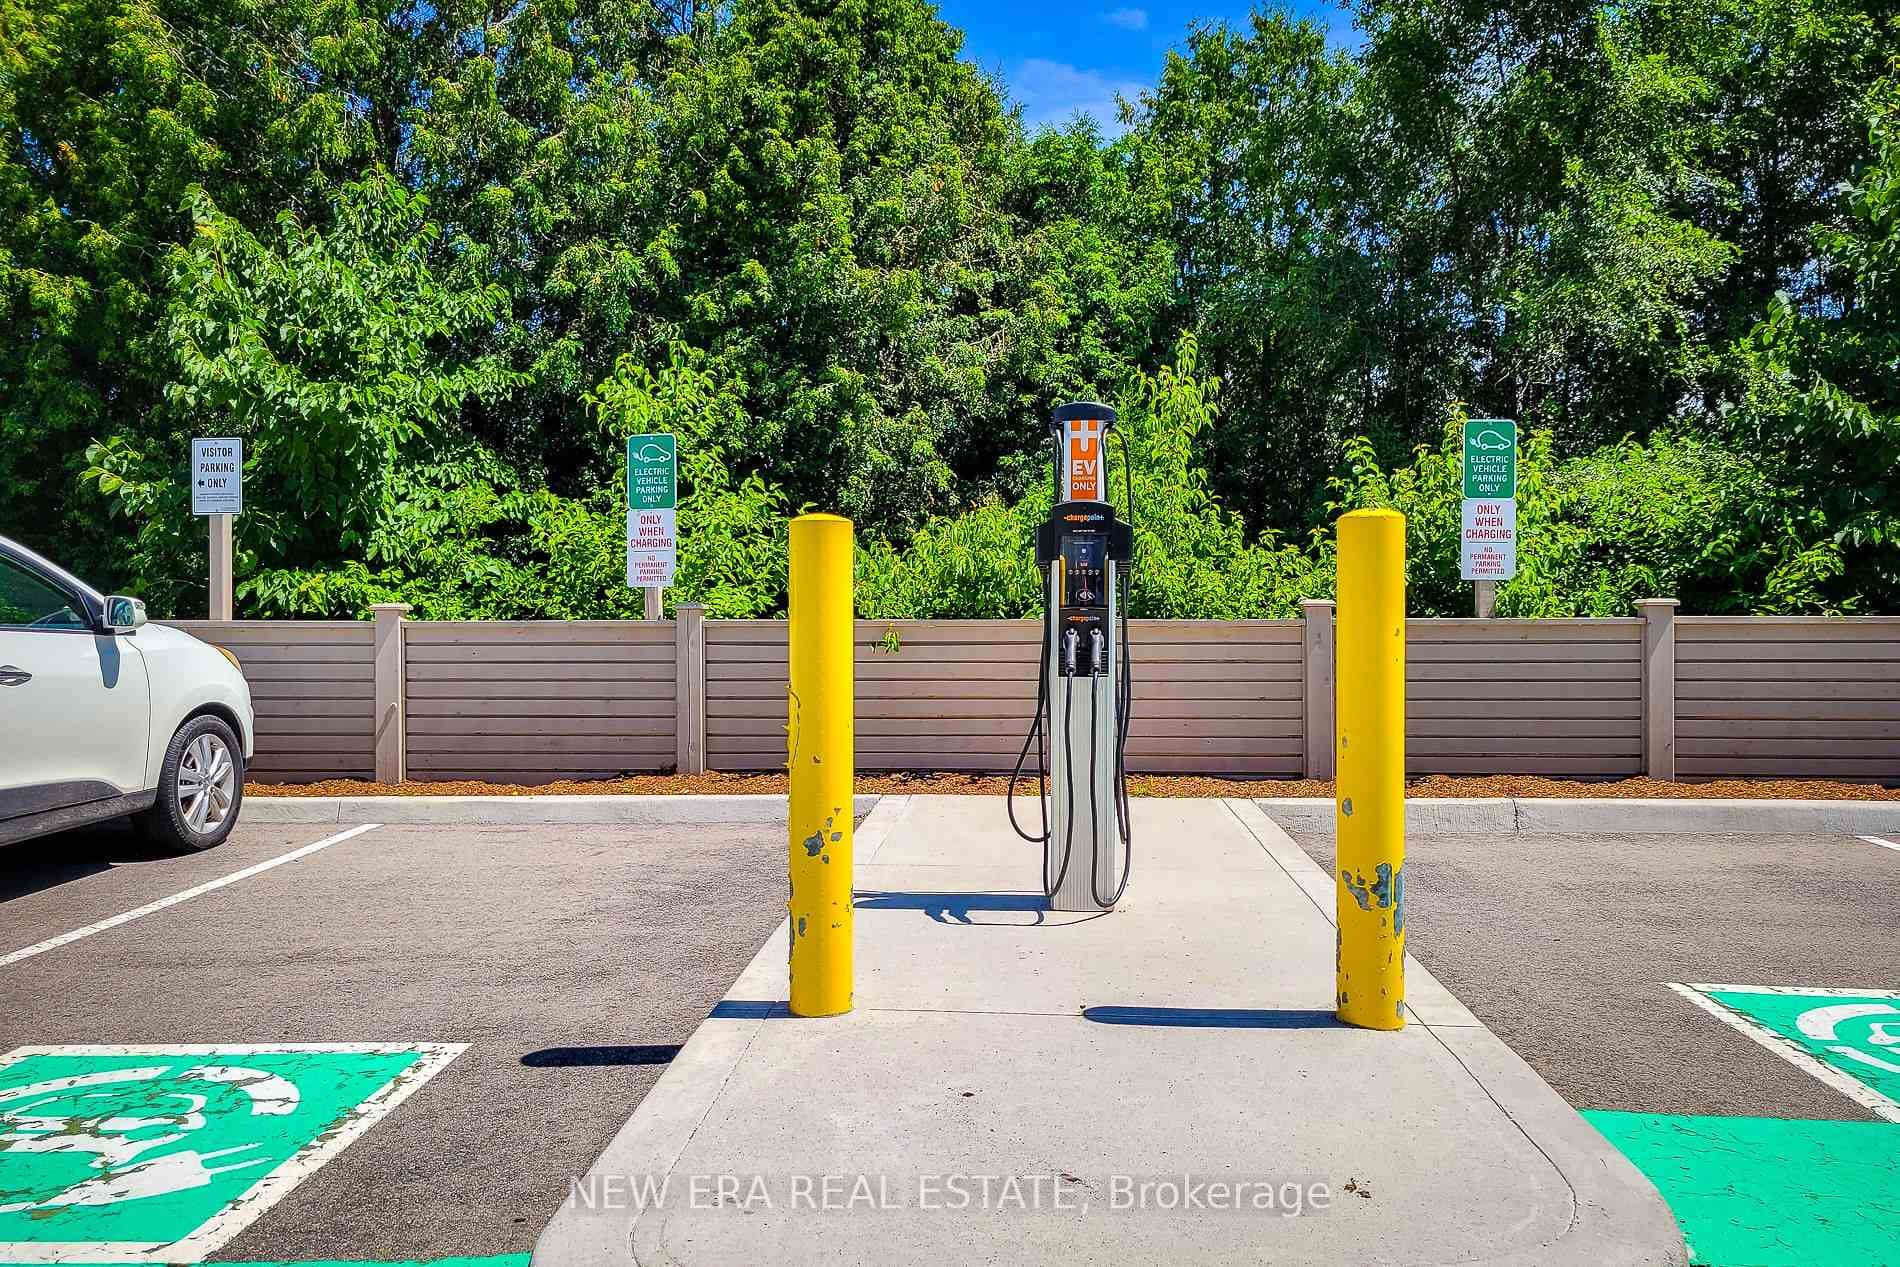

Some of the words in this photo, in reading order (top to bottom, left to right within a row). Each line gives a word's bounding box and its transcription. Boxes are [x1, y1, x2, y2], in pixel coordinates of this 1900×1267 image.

[201, 447, 233, 458] VISITOR
[1470, 455, 1509, 464] ELECTRIC
[200, 462, 235, 473] PARKING
[634, 467, 670, 476] ELECTRIC
[1072, 459, 1097, 475] EV
[1472, 464, 1508, 473] VEHICLE
[636, 476, 669, 485] VEHICLE
[1472, 474, 1508, 482] PARKING
[207, 478, 228, 489] ONLY
[1072, 481, 1096, 491] ONLY
[1478, 483, 1500, 492] ONLY
[636, 485, 669, 494] PARKING
[642, 495, 662, 503] ONLY
[1477, 504, 1501, 515] ONLY
[640, 515, 662, 525] ONLY
[1475, 517, 1503, 527] WHEN
[638, 527, 665, 537] WHEN
[1465, 529, 1512, 539] CHARGING
[630, 538, 672, 548] CHARGING
